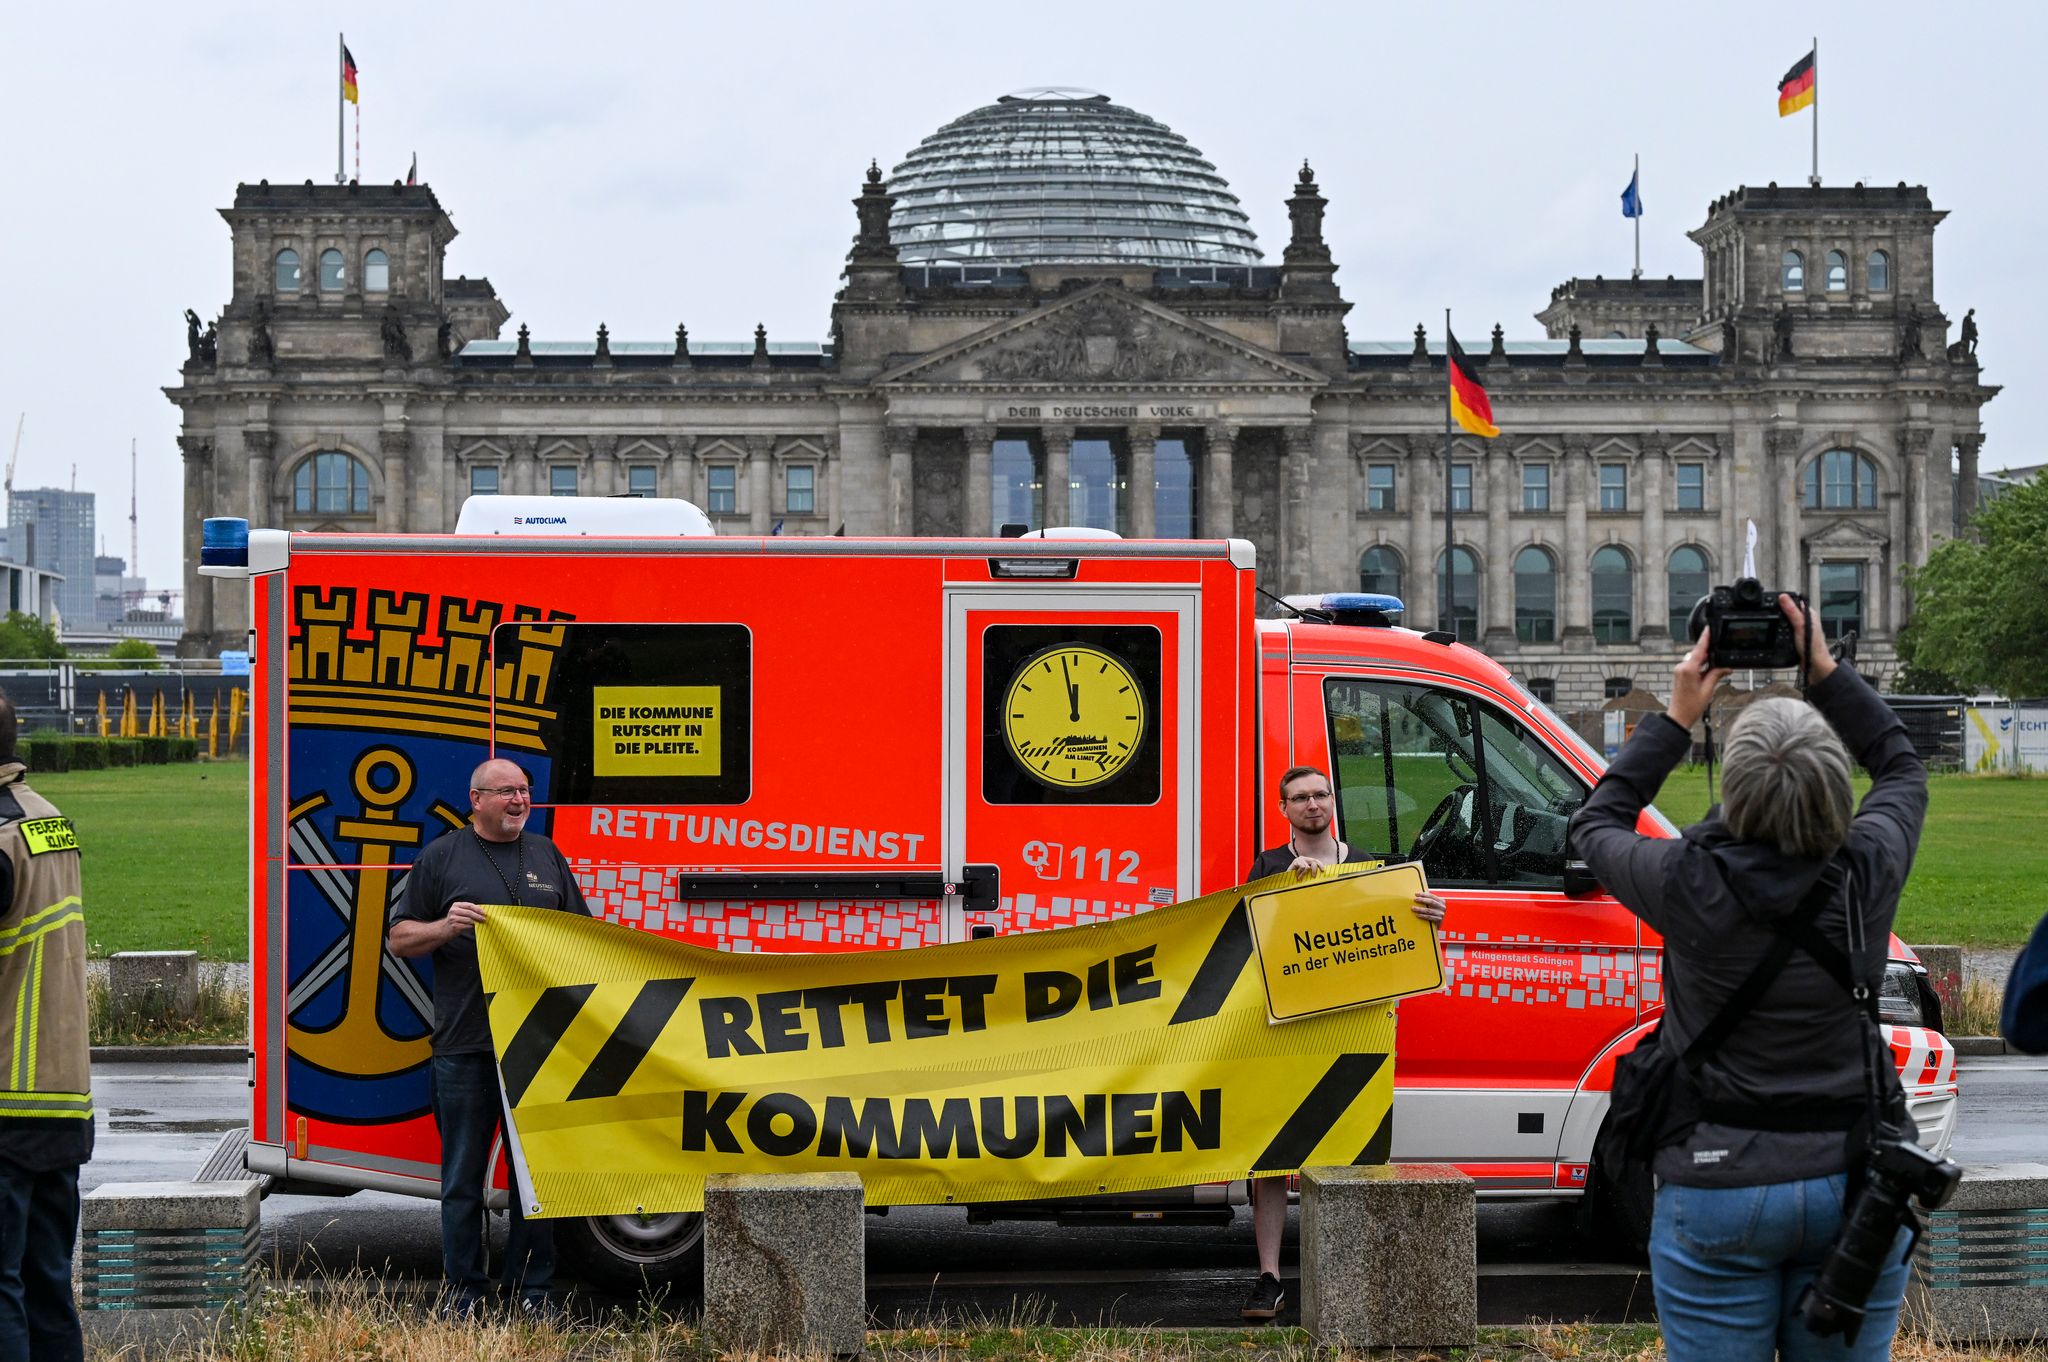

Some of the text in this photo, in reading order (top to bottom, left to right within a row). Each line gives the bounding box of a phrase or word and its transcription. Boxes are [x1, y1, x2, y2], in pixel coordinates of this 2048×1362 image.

[1009, 406, 1194, 417] DEM DEUTSCHEN VOLKE
[600, 707, 713, 719] DIE KOMMUNE
[612, 725, 702, 736] RUTSCHT IN
[615, 742, 699, 754] DIE PLEITE.
[1067, 745, 1107, 753] KOMMUNEN
[589, 807, 925, 862] RETTUNGSDIENST
[1070, 846, 1140, 884] 112
[1294, 915, 1397, 953] Neustadt
[1283, 938, 1416, 976] an der Weinstraße
[1471, 950, 1574, 967] Klingenstadt Solingen
[1471, 964, 1573, 985] FEUERWEHR
[698, 943, 1162, 1059] RETTET DIE
[682, 1088, 1222, 1159] KOMMUNEN
